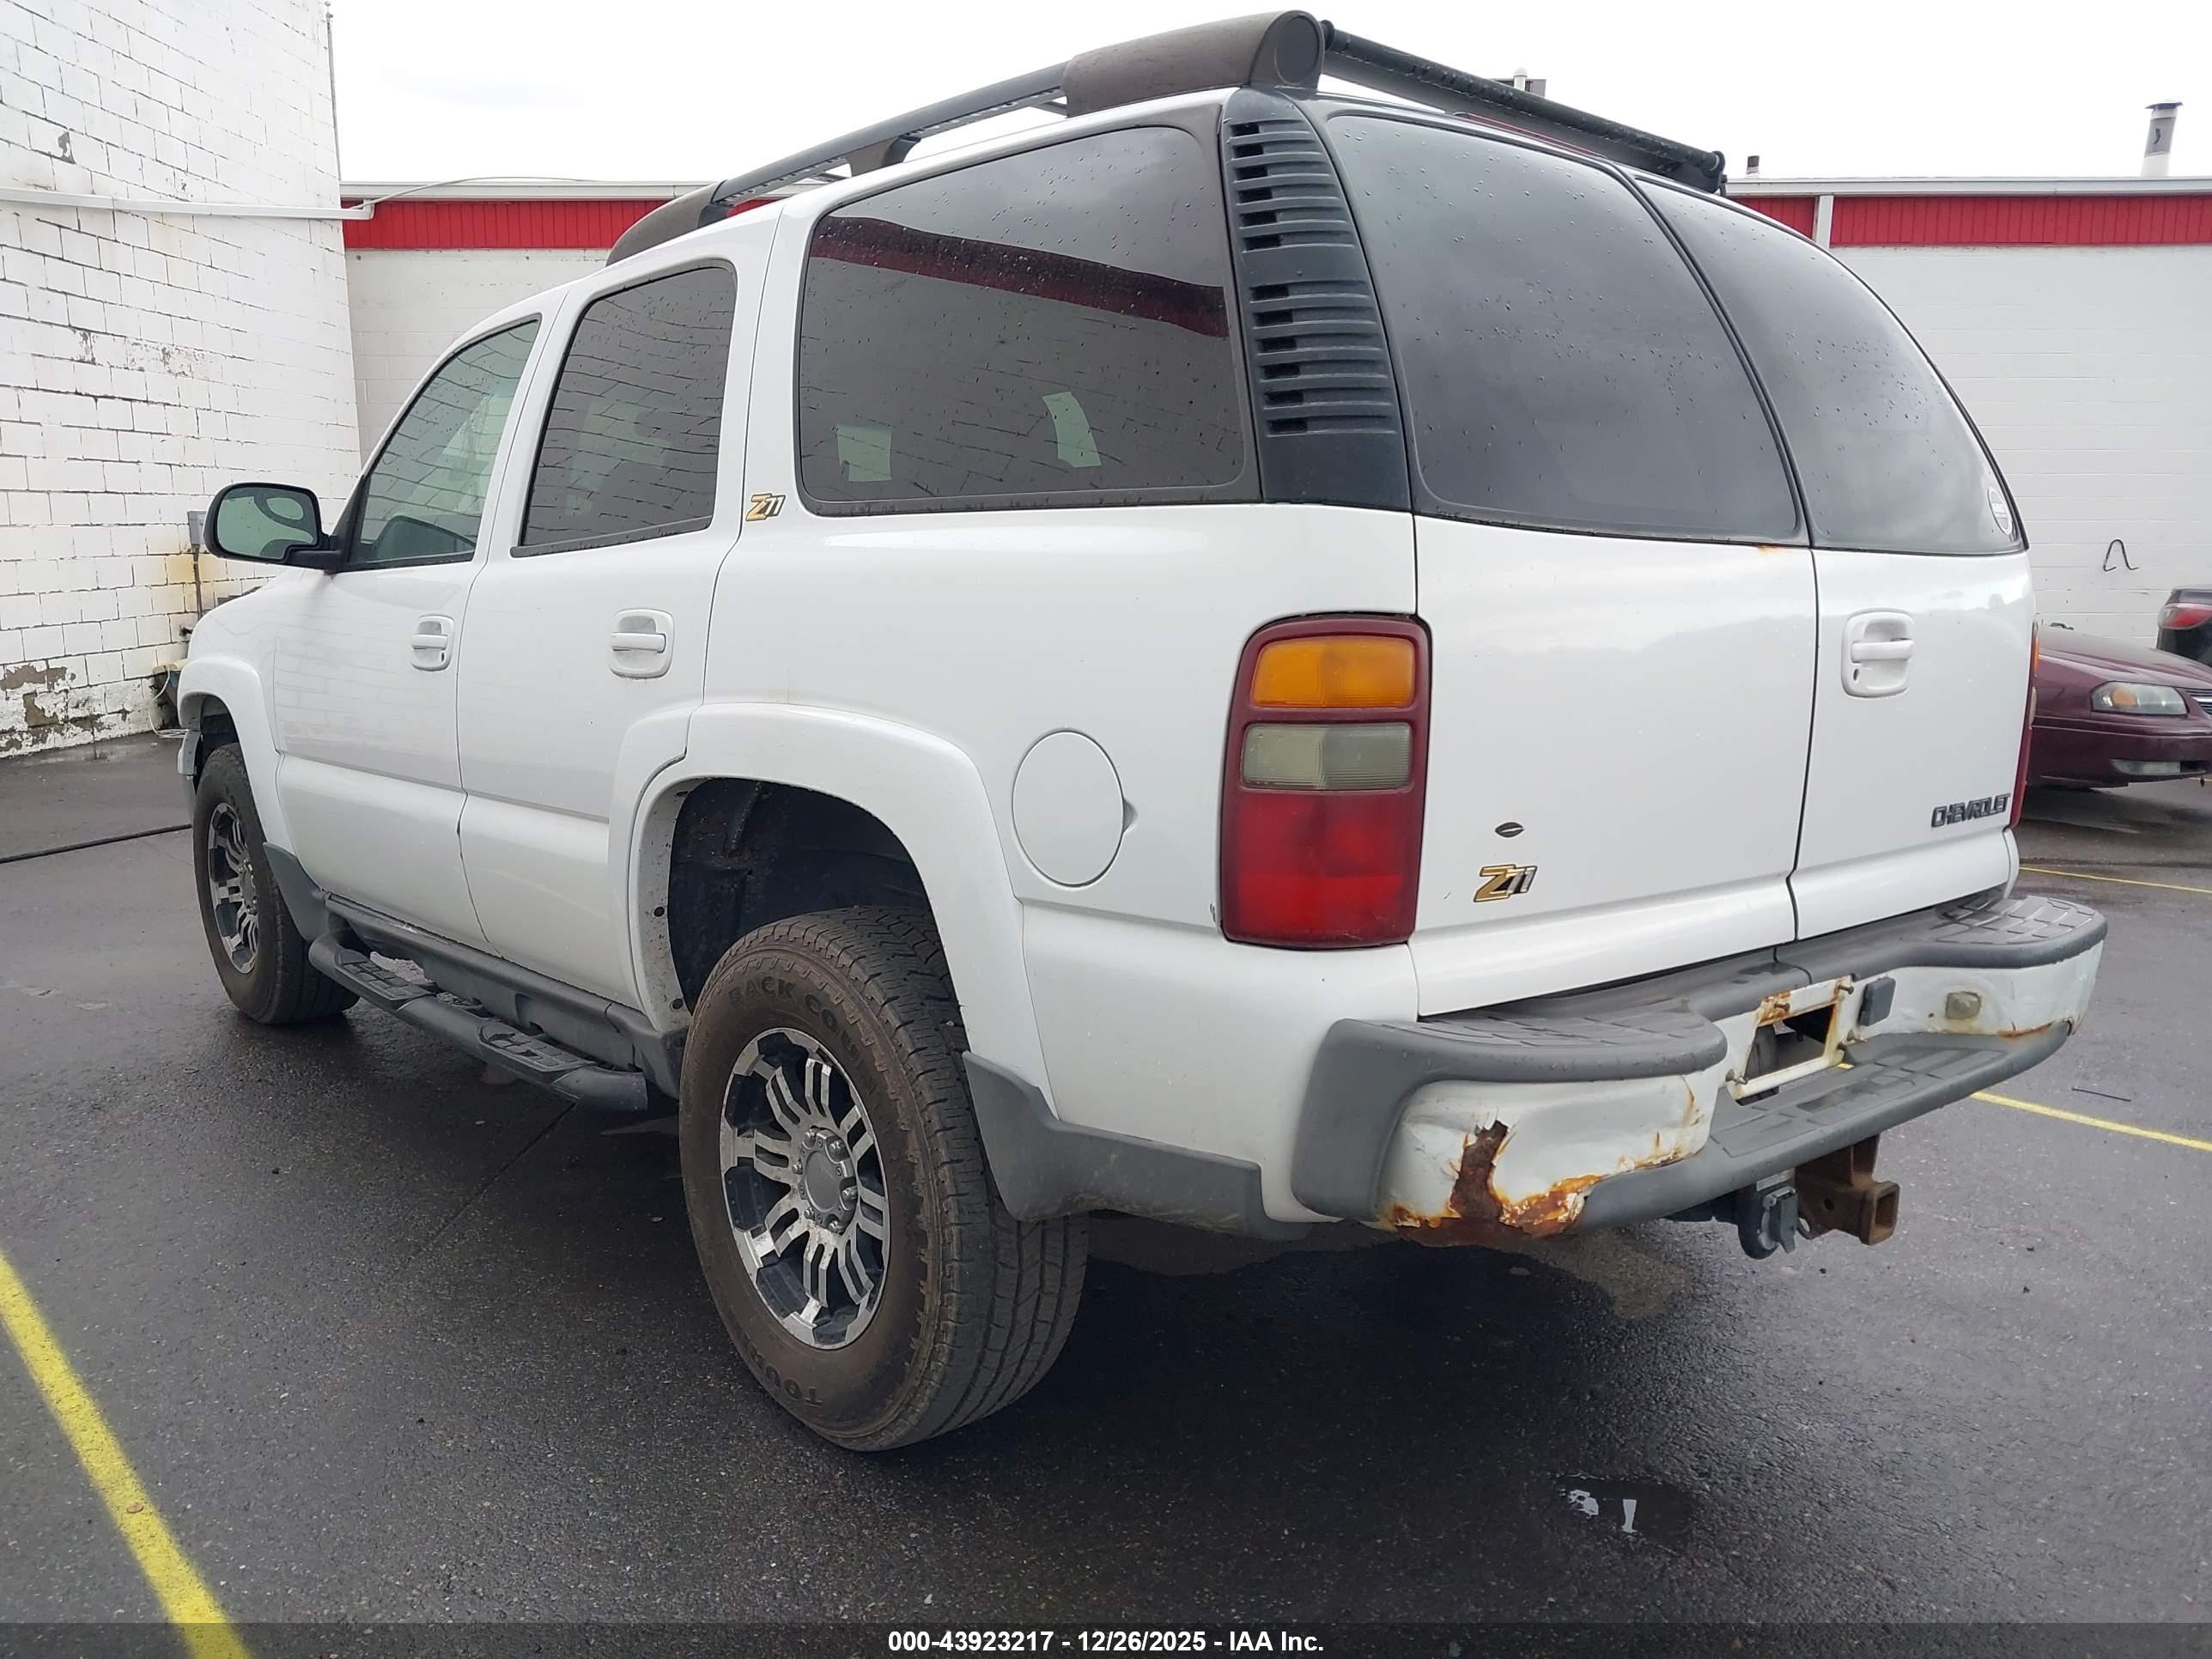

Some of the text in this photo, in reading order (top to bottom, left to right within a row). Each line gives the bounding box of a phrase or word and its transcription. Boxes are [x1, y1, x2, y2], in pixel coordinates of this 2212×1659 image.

[745, 493, 786, 521] Z71
[1931, 793, 2011, 828] CHEVROLET
[1474, 864, 1538, 902] Z71
[728, 976, 796, 1006] BACK
